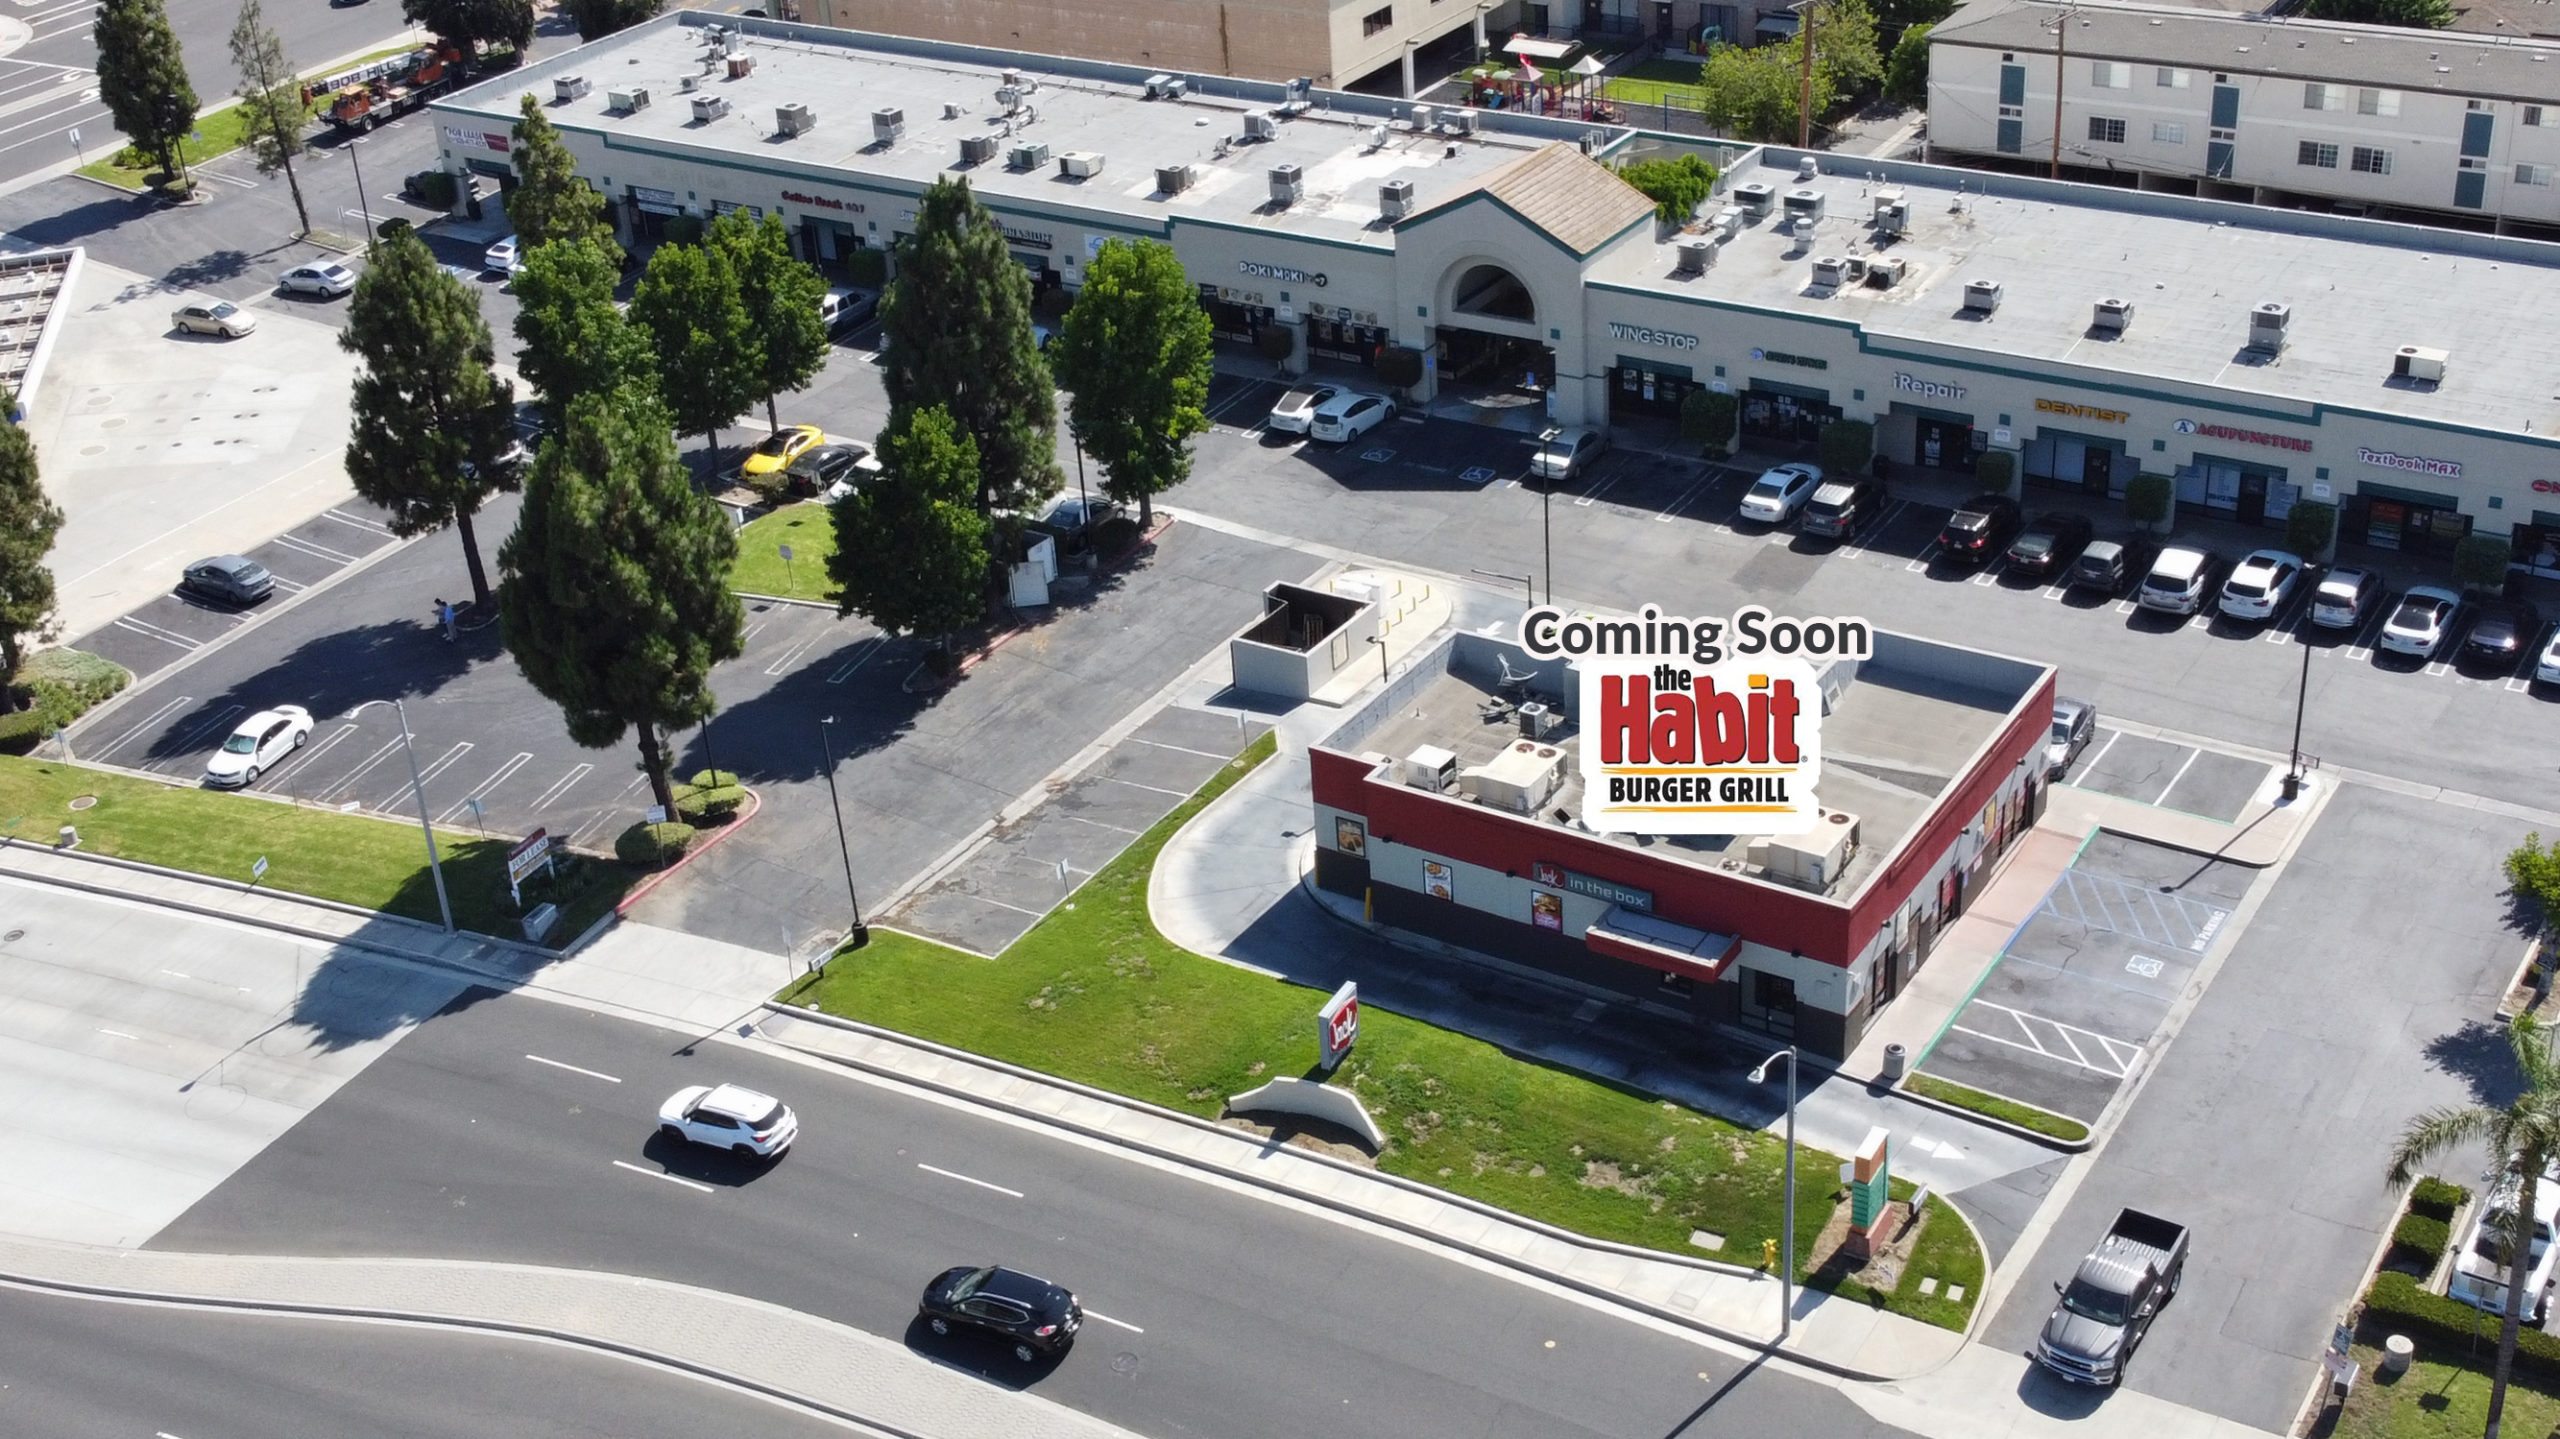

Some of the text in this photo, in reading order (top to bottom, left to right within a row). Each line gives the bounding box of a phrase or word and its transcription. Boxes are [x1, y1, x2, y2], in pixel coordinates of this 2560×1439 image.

[1239, 261, 1271, 277] POKI
[1893, 372, 1967, 400] iRepair
[2035, 398, 2130, 424] DENTIST
[2196, 422, 2313, 452] ACUPUNCTURE
[2359, 449, 2460, 477] Textbook MAX
[1569, 878, 1584, 889] in
[1586, 881, 1612, 898] the
[1615, 890, 1645, 907] box
[1331, 1007, 1357, 1050] Jack
